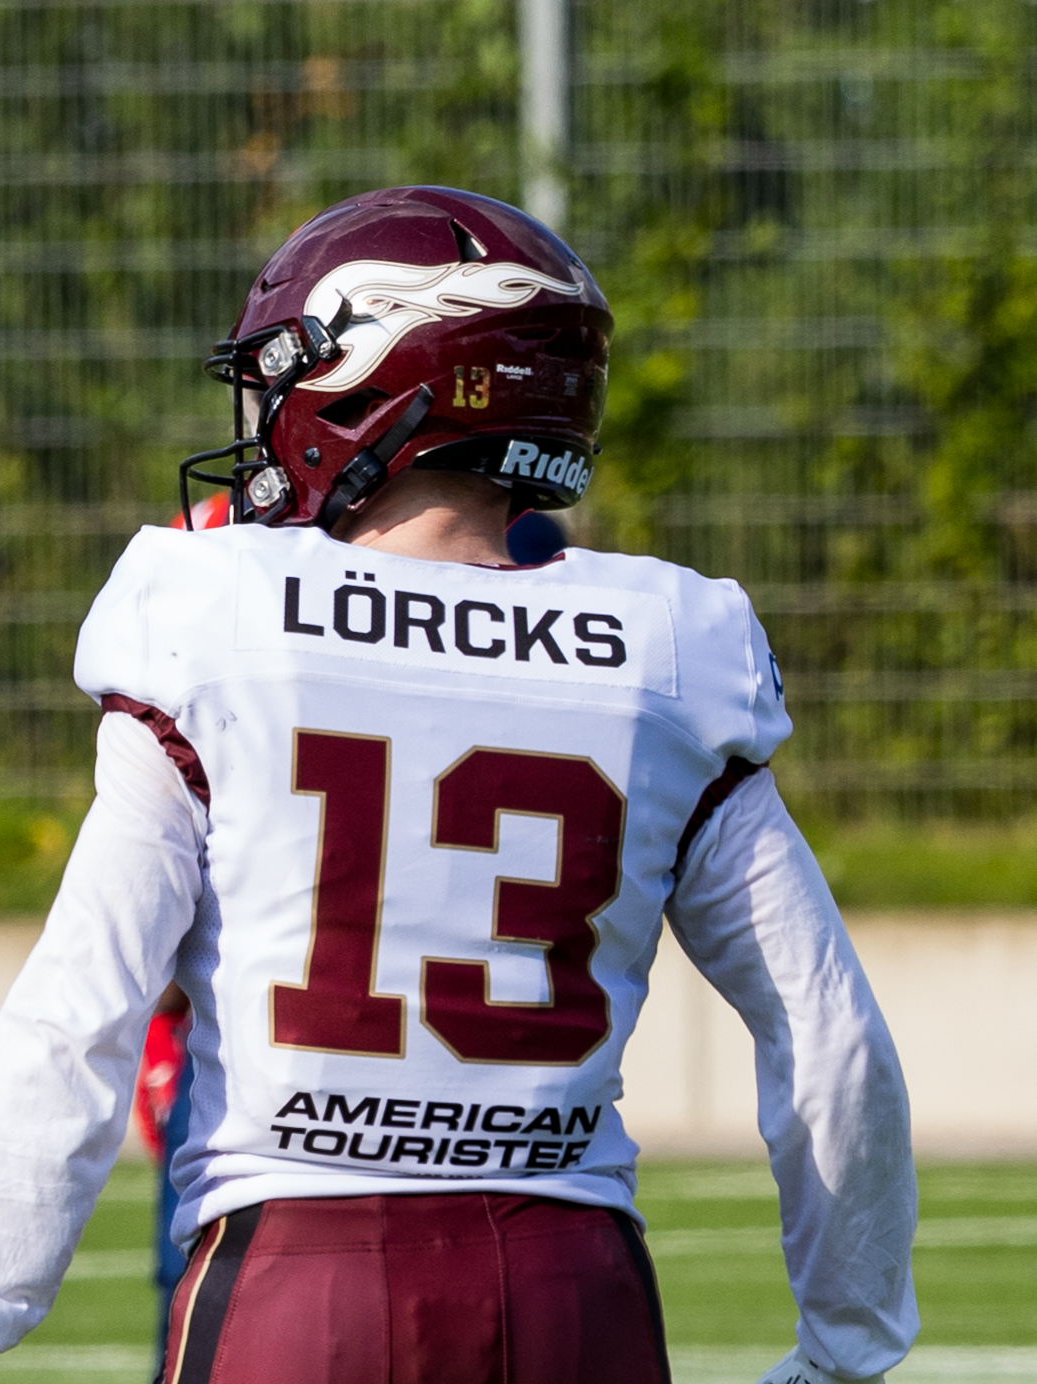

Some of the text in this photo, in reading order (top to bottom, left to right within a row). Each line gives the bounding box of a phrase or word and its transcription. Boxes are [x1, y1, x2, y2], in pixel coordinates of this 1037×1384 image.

[452, 365, 490, 409] 13
[496, 363, 532, 376] Riddell
[283, 570, 627, 668] LÖRCKS
[268, 727, 627, 1067] 13
[275, 1091, 602, 1135] AMERICAN
